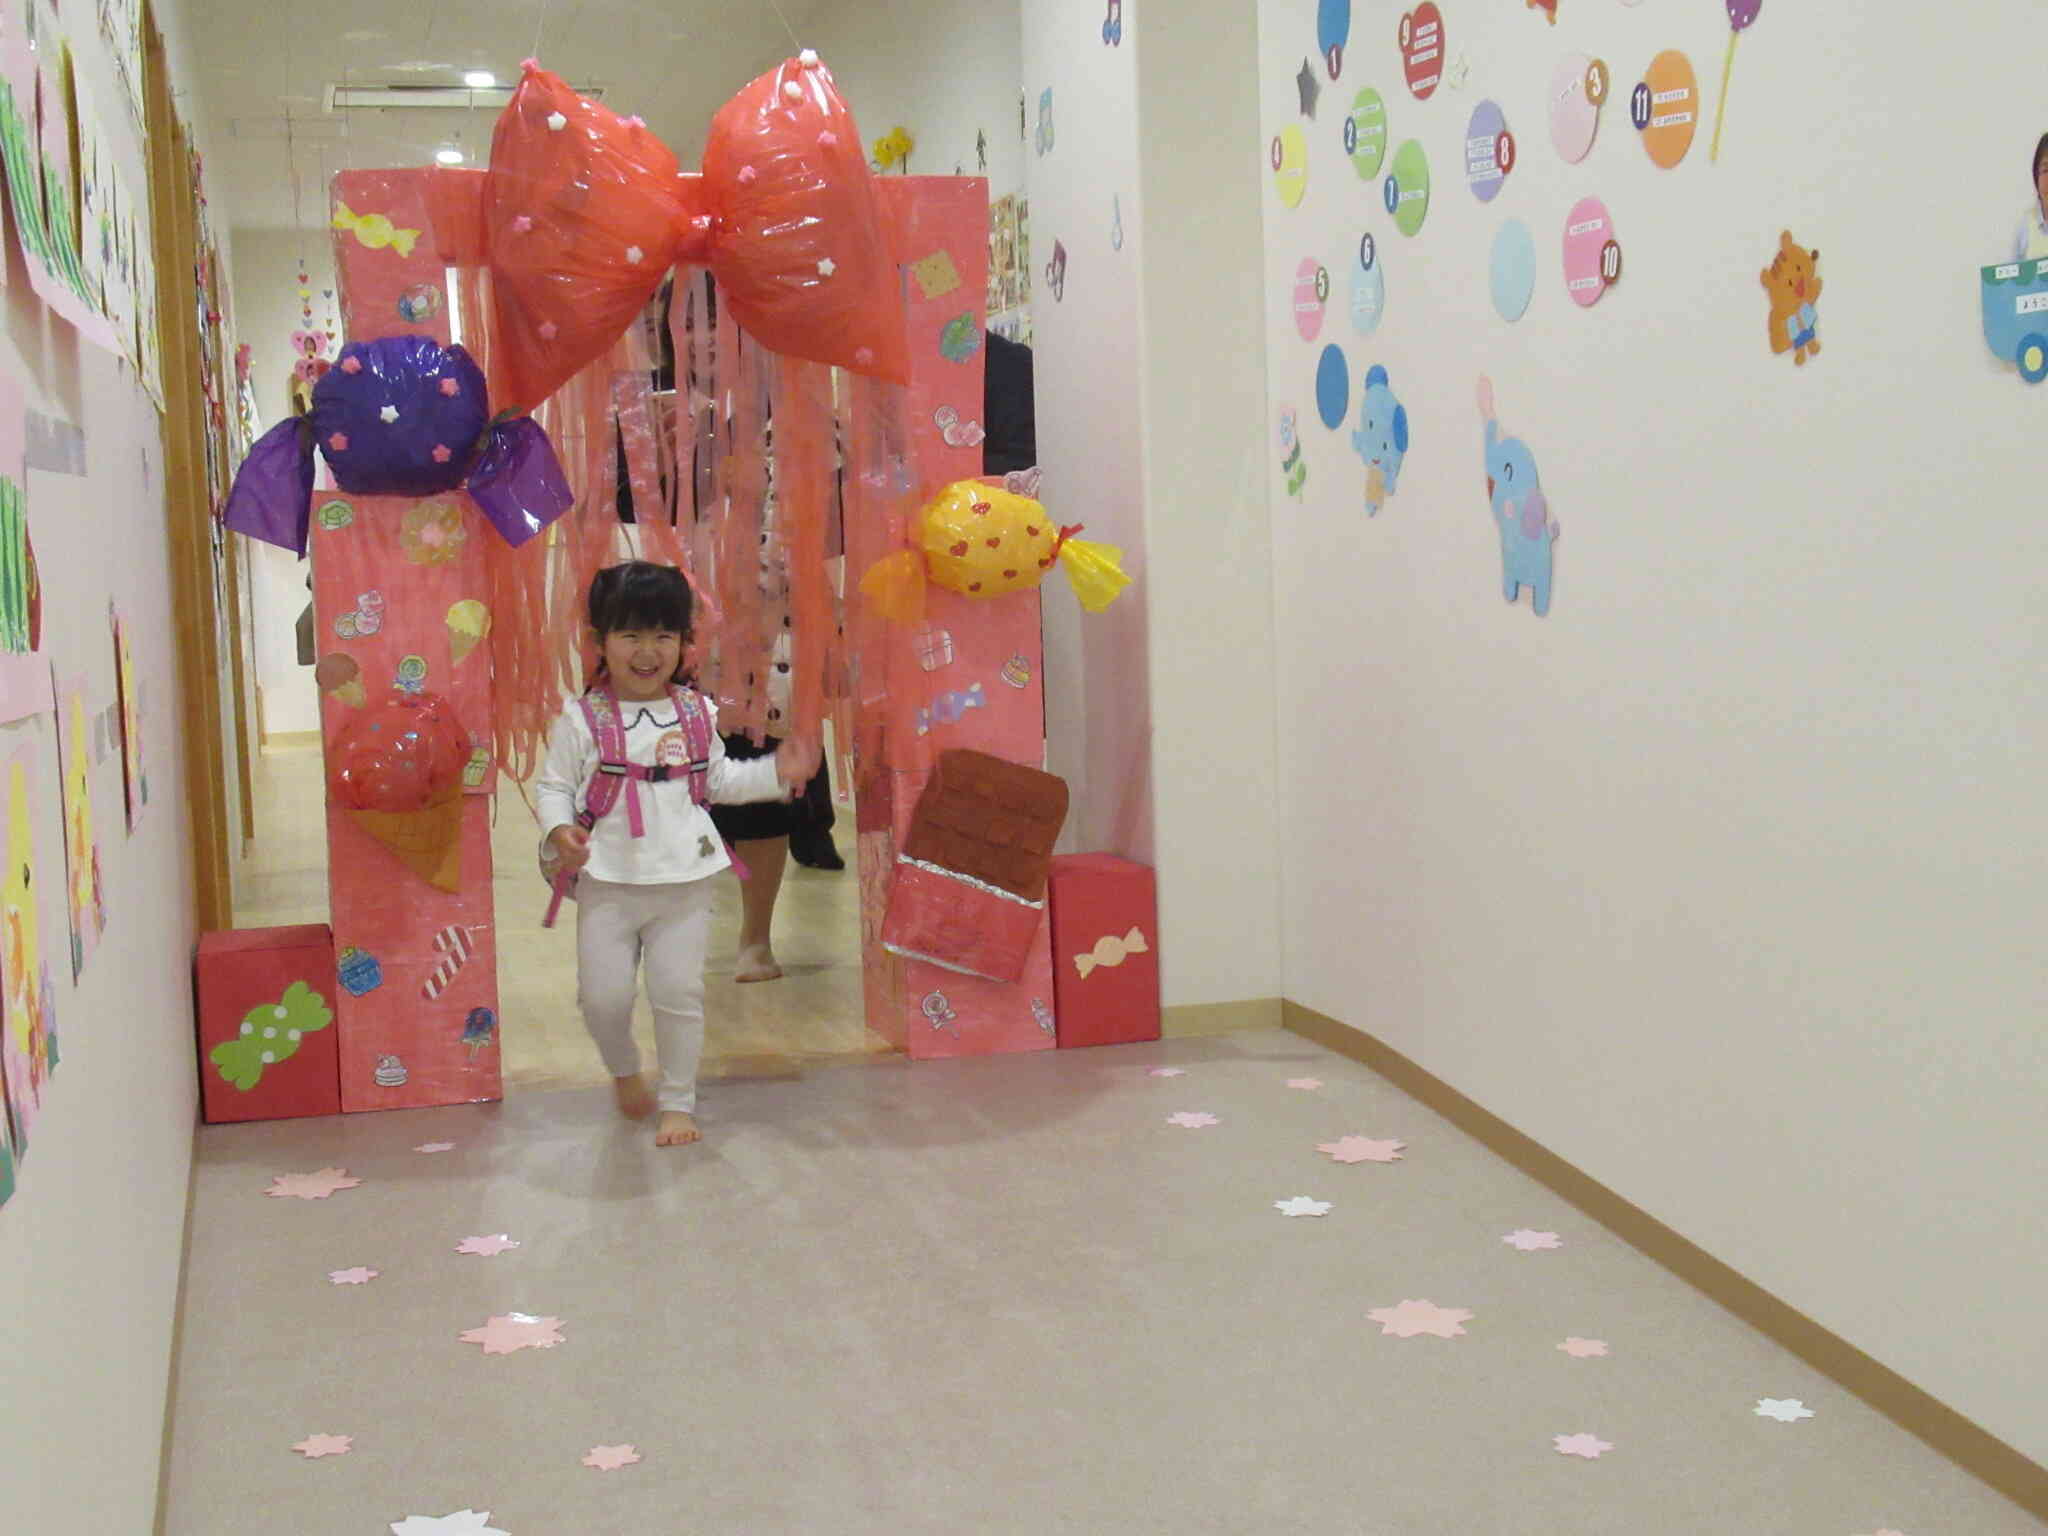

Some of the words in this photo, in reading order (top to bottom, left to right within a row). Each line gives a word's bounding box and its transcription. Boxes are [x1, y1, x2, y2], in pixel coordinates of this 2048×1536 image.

[1403, 18, 1410, 47] 9
[1590, 66, 1602, 97] 3
[1635, 87, 1648, 121] 11
[1347, 122, 1354, 149] 2
[1500, 135, 1509, 167] 8
[1363, 237, 1371, 265] 6
[1603, 246, 1619, 277] 10
[1317, 269, 1326, 298] 5
